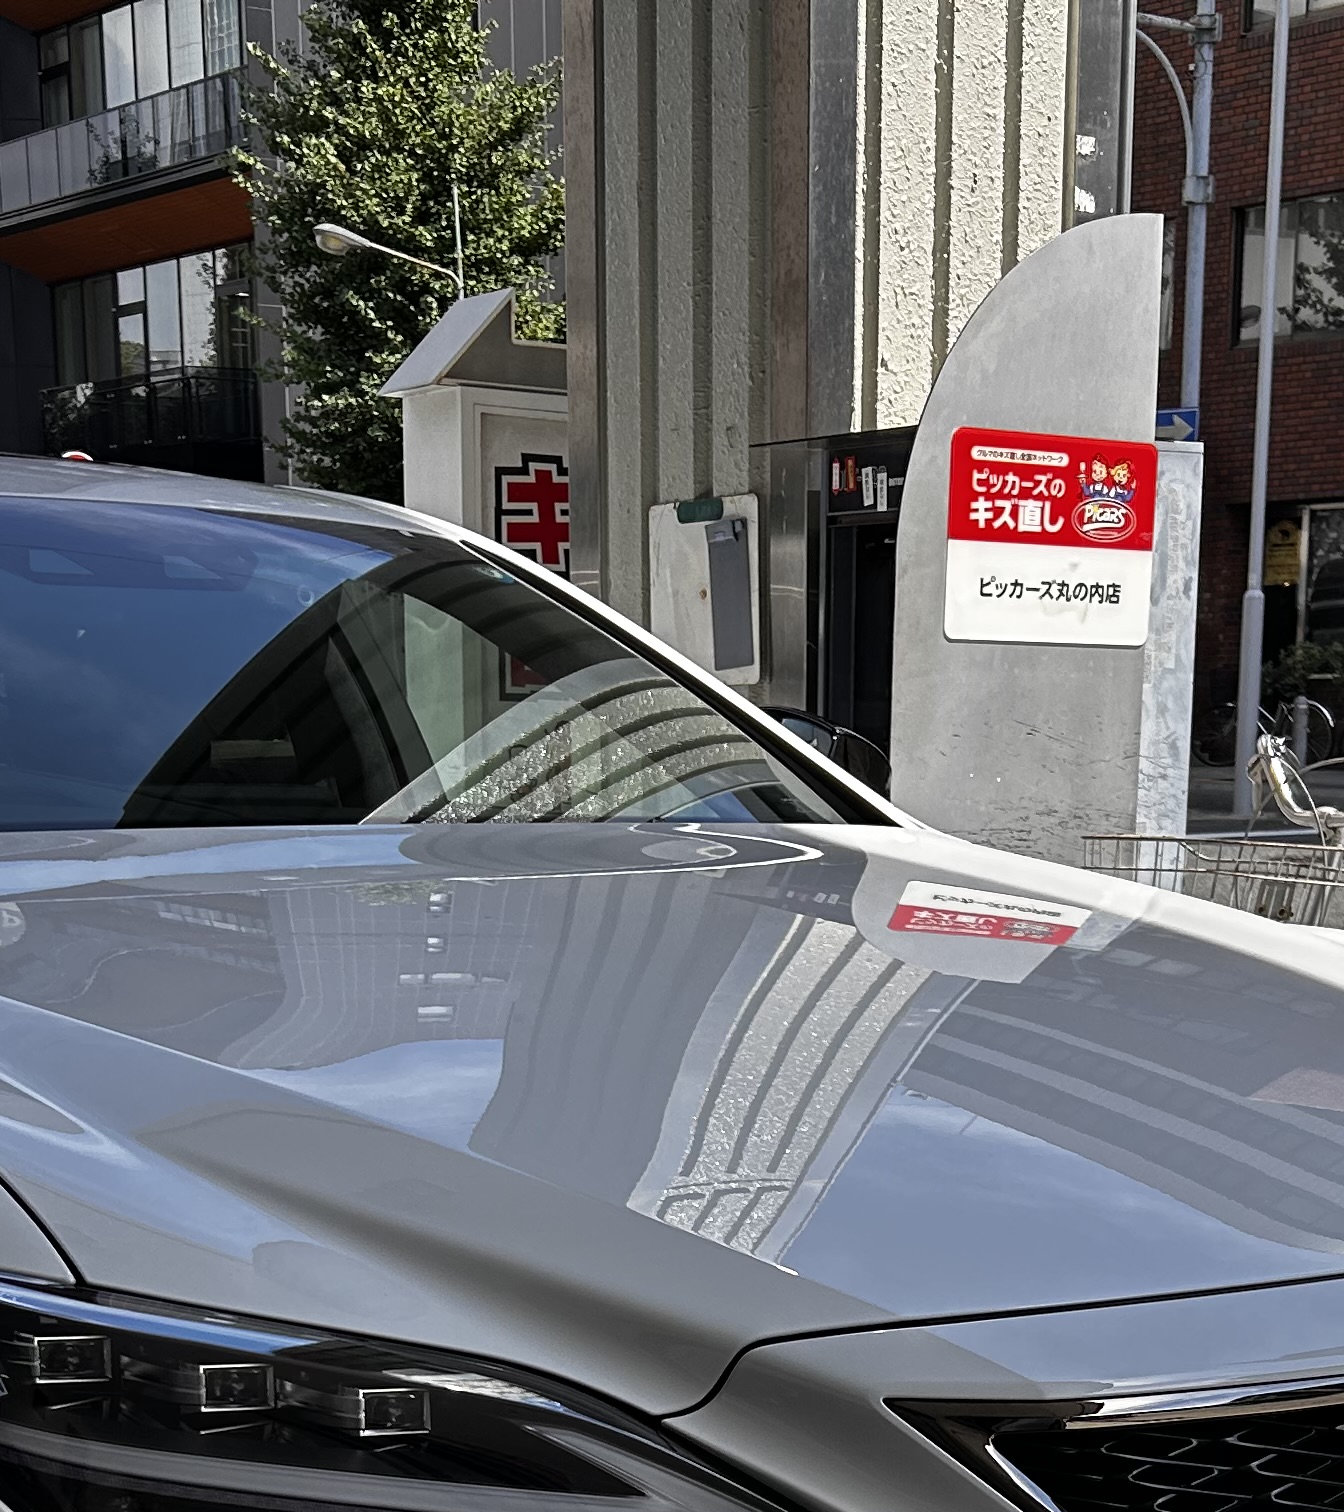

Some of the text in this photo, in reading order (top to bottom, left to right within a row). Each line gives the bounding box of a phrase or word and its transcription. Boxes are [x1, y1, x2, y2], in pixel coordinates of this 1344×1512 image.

[971, 467, 1067, 499] ピッカーズの
[968, 495, 1066, 534] キズ直し
[978, 575, 1122, 605] ピッカーズ丸の内店
